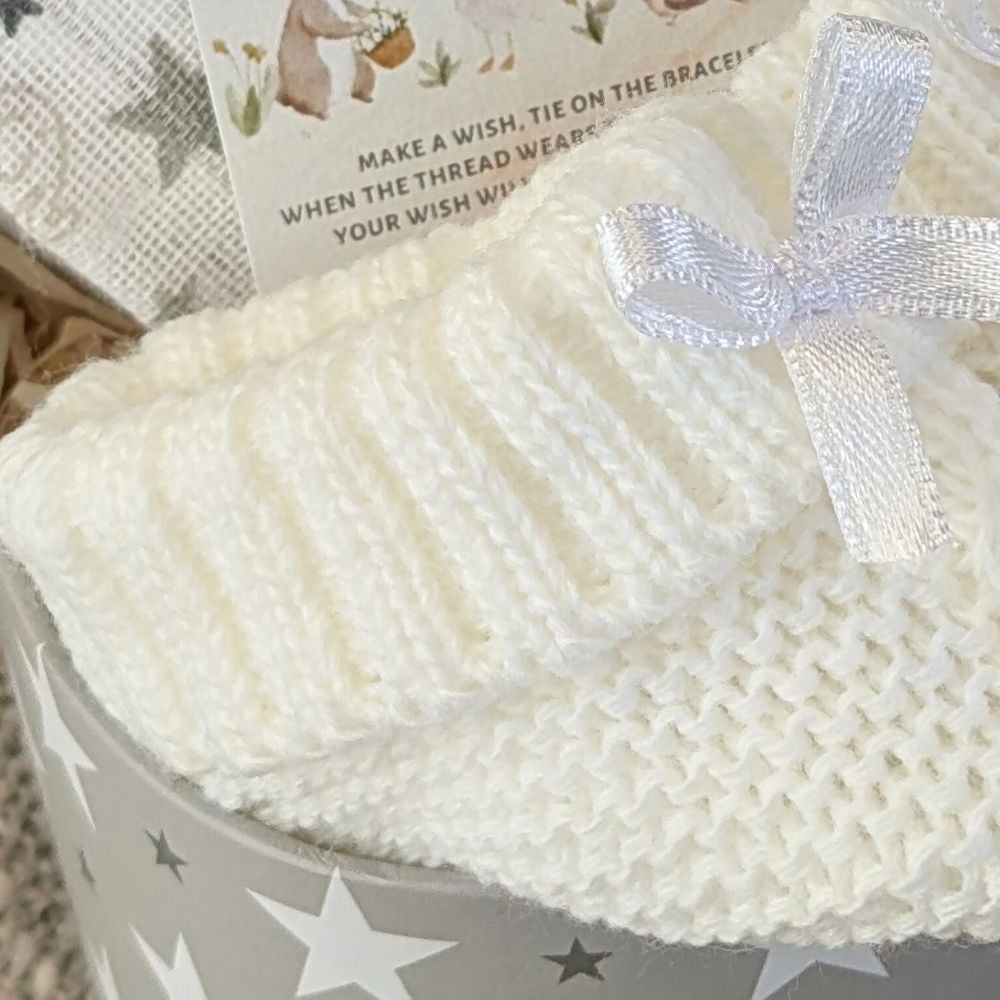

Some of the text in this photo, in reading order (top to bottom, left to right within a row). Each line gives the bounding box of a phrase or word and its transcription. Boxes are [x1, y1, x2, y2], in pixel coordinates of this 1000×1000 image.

[358, 139, 428, 173] MAKE
[431, 133, 448, 153] A
[452, 114, 526, 146] WISH,
[528, 101, 567, 126] TIE
[570, 87, 606, 115] ON
[609, 73, 659, 105] THE
[662, 40, 768, 89] BRACEL
[280, 190, 357, 227] WHEN
[360, 176, 411, 205] THE
[412, 149, 512, 191] THREAD
[332, 213, 403, 247] YOUR
[405, 193, 473, 227] WISH
